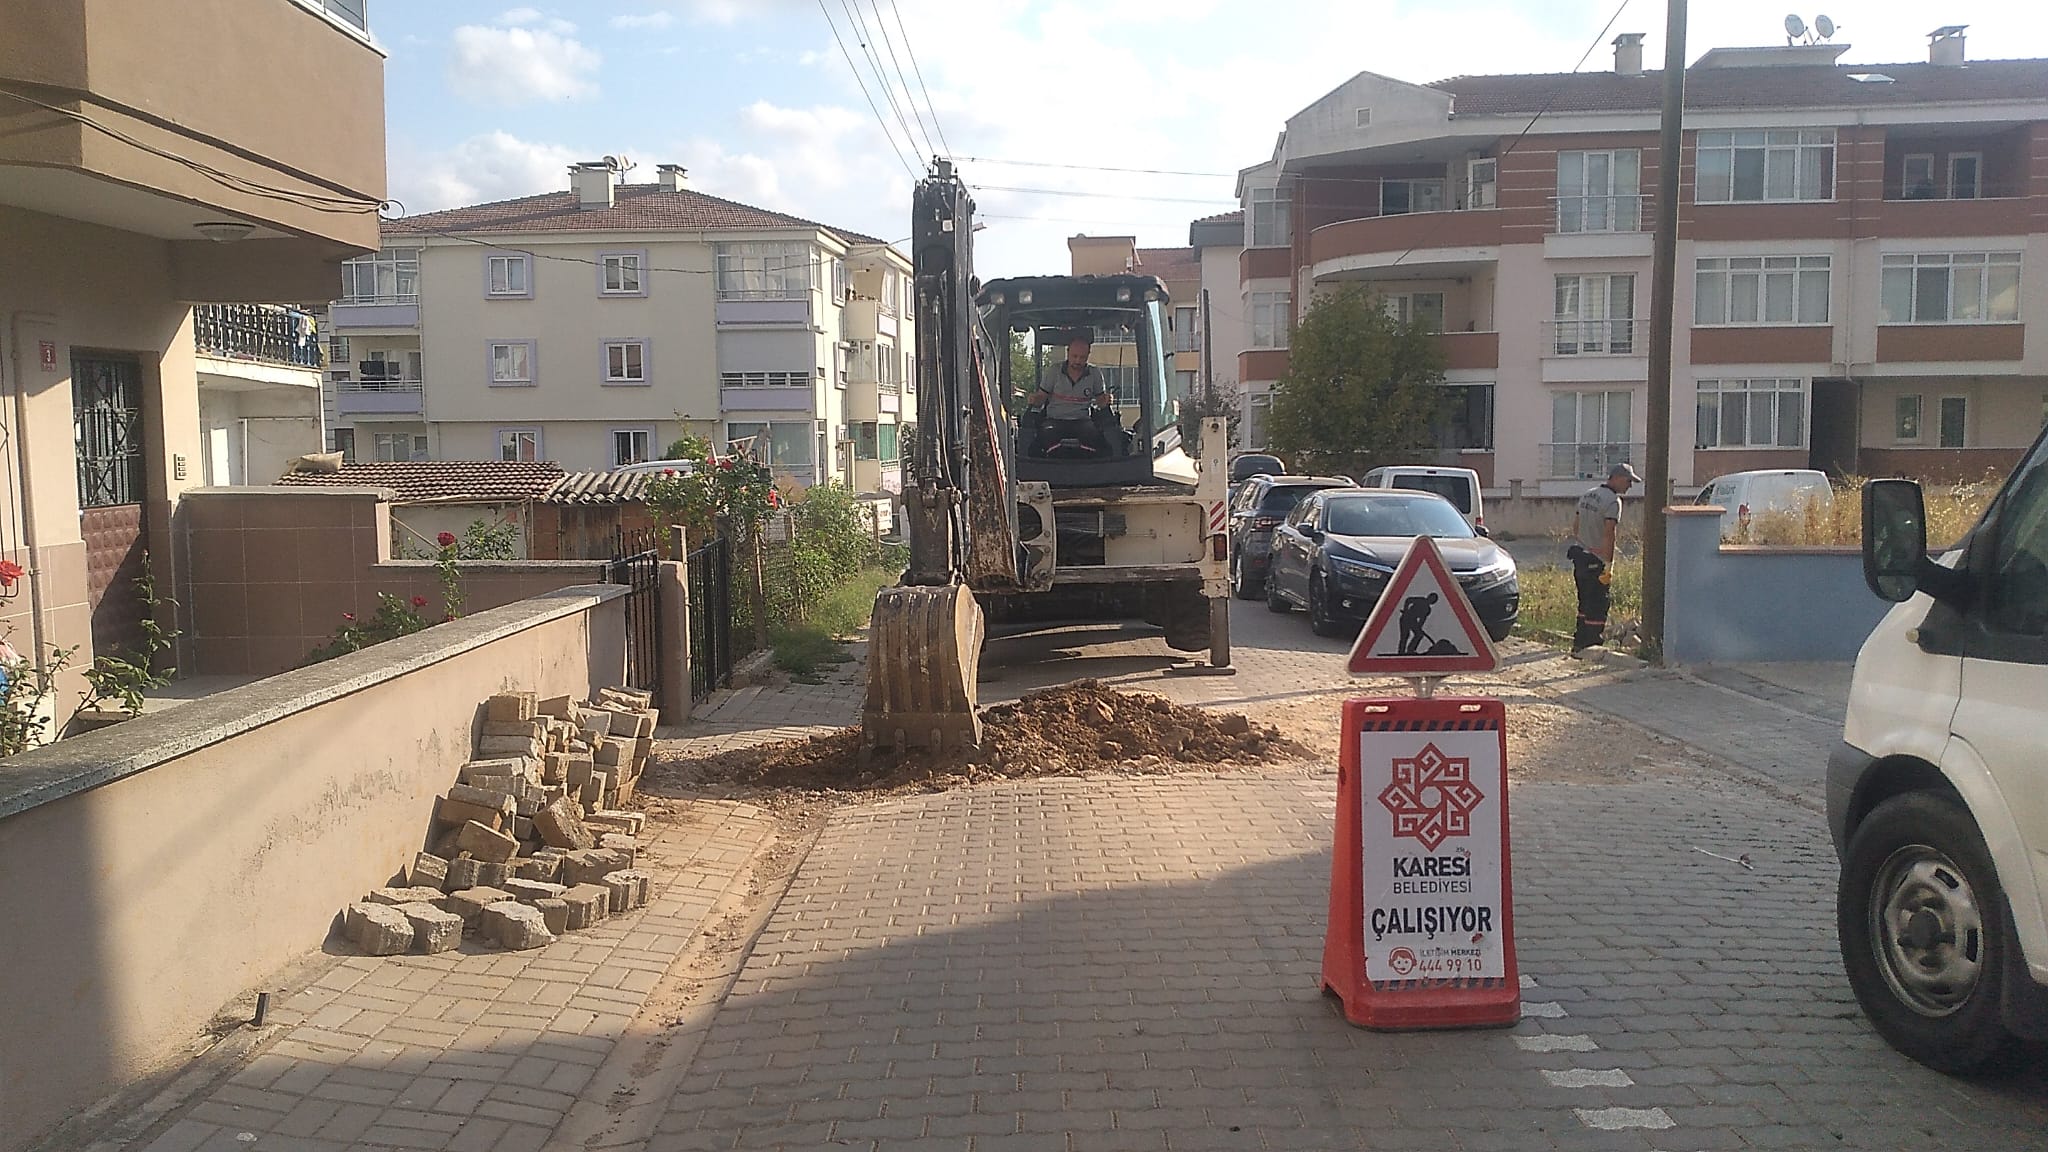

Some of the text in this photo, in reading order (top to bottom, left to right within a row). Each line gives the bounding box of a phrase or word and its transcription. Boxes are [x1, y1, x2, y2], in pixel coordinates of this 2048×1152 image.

[1393, 878, 1472, 894] BELEDİYESİ
[1371, 905, 1492, 941] ÇALIŞIYOR
[1419, 958, 1482, 971] 444 99 10
